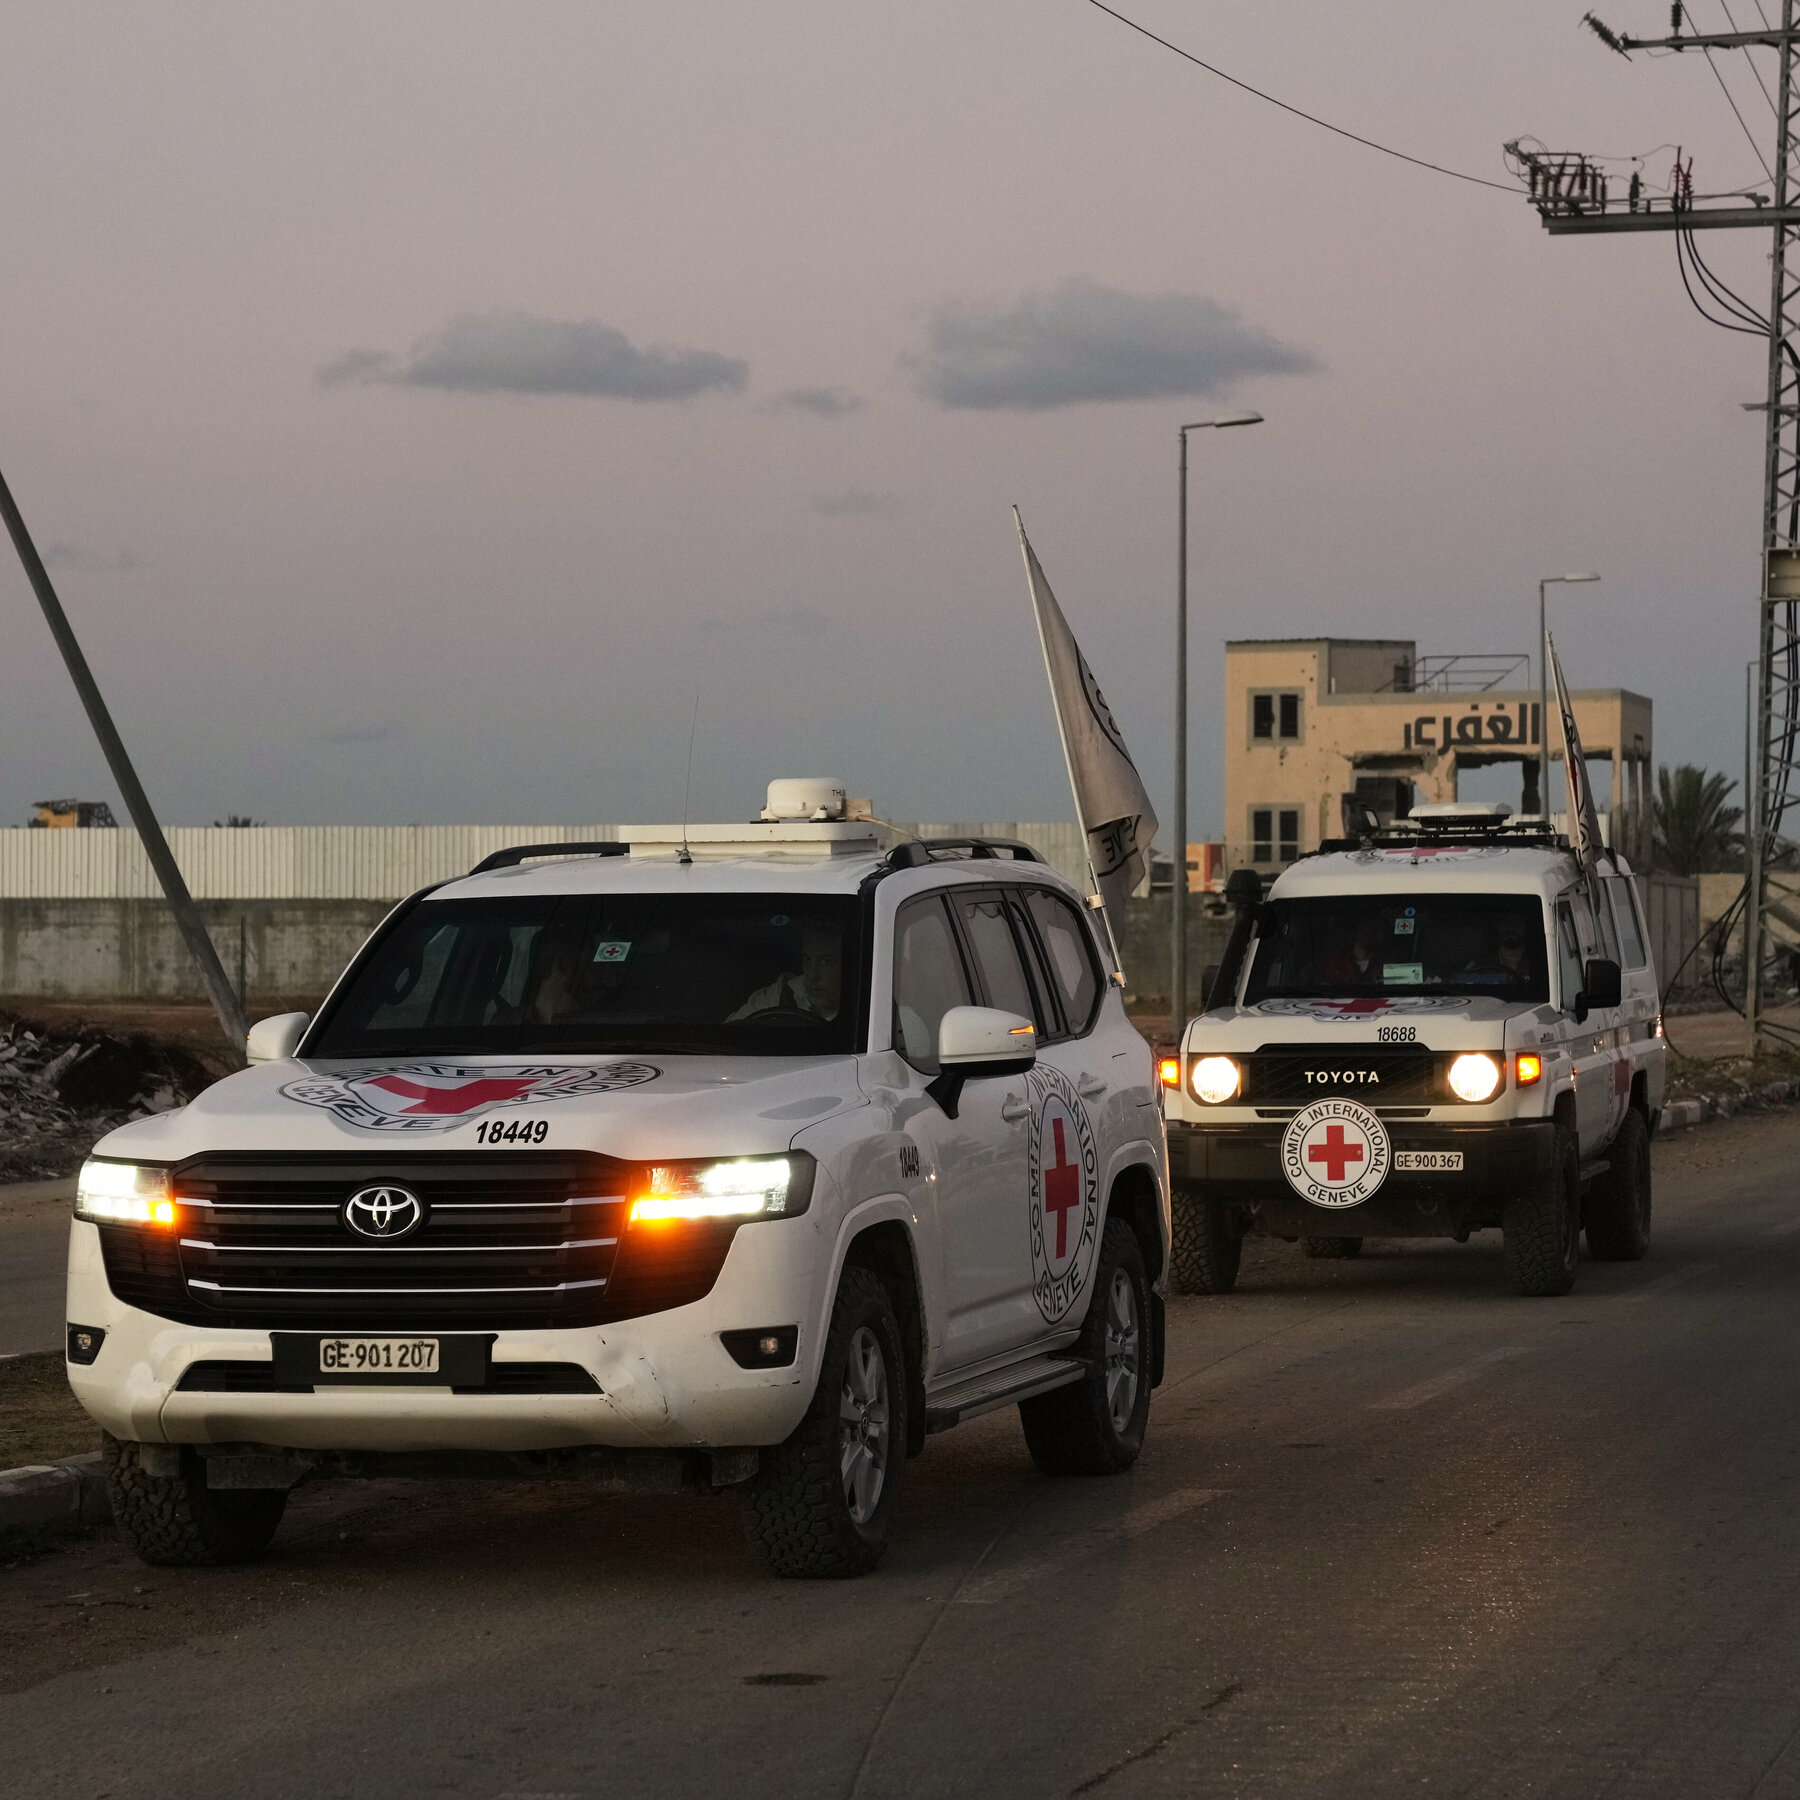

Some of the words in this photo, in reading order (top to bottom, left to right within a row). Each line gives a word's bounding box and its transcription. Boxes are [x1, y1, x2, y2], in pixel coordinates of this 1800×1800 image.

[1377, 1027, 1416, 1042] 18688
[1304, 1071, 1380, 1084] TOYOTA
[475, 1120, 549, 1144] 18449
[1286, 1119, 1308, 1178] COMITE
[1307, 1103, 1386, 1175] INTERNATIONAL
[899, 1145, 920, 1178] 18449
[1030, 1104, 1040, 1258] COMITE
[1306, 1182, 1369, 1204] GENEVE
[1036, 1269, 1082, 1315] GENEVE
[397, 1343, 436, 1369] 207
